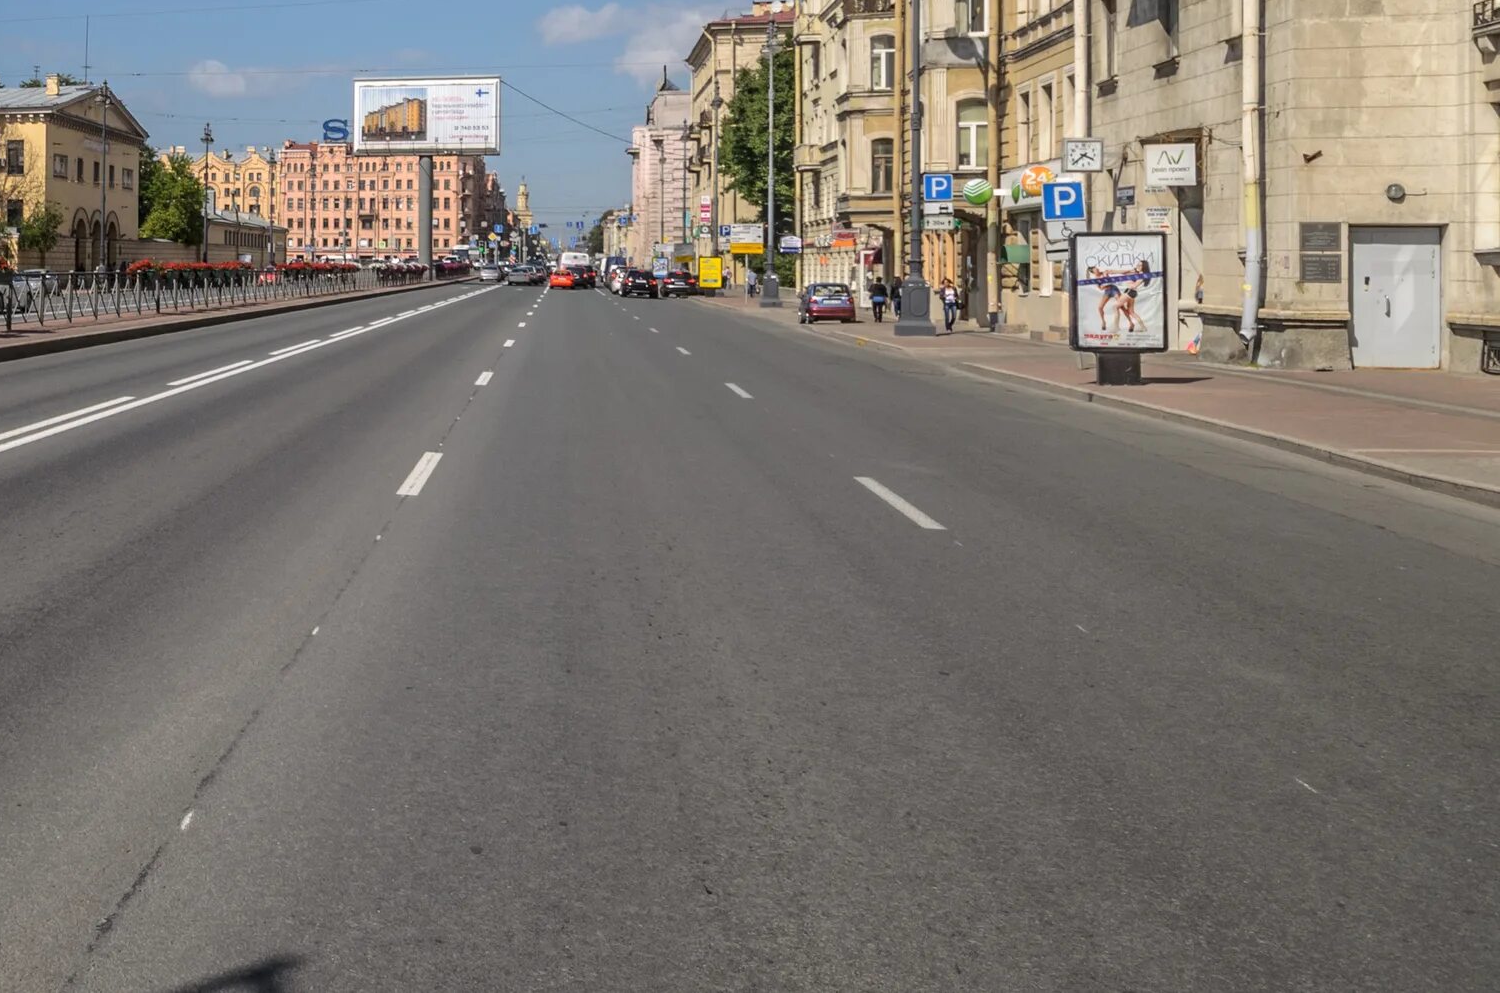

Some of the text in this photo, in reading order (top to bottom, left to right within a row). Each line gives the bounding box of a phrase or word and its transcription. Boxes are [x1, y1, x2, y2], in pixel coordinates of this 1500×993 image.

[1026, 172, 1046, 185] 24
[932, 177, 948, 198] P
[1053, 186, 1077, 216] P
[1099, 239, 1137, 253] ХОЧУ
[1085, 251, 1154, 268] СКИДКИ
